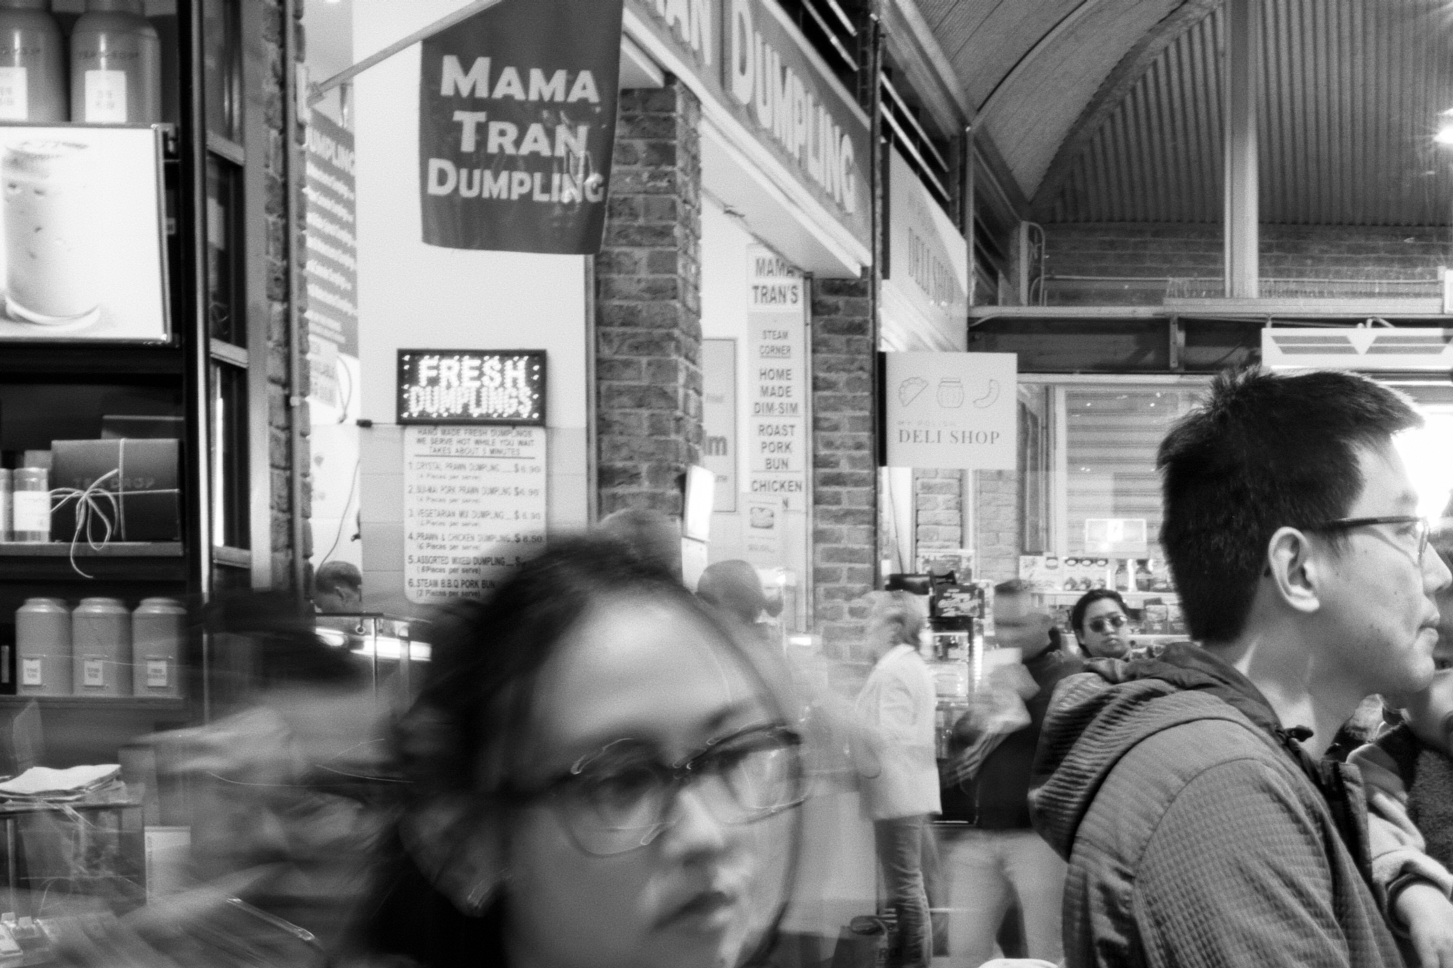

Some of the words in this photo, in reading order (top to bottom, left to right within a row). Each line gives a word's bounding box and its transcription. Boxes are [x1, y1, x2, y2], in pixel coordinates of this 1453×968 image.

[440, 55, 599, 103] MAMA
[732, 0, 855, 213] DUMPLING
[452, 110, 590, 157] TRAN
[427, 158, 604, 203] DUMPLING
[752, 284, 798, 304] TRAN'S
[762, 330, 788, 340] STEAM
[759, 345, 791, 355] CORNER
[418, 359, 526, 388] FRESH
[760, 369, 792, 381] HOME
[760, 386, 792, 398] MADE
[409, 386, 532, 414] DUMPLINGS
[754, 402, 798, 414] DIM-SIM
[758, 424, 796, 437] ROAST
[898, 429, 942, 444] DELI
[949, 430, 1000, 445] SHOP
[761, 441, 792, 453] PORK
[765, 458, 789, 470] BUN
[752, 480, 803, 492] CHICKEN
[461, 579, 480, 588] PORK
